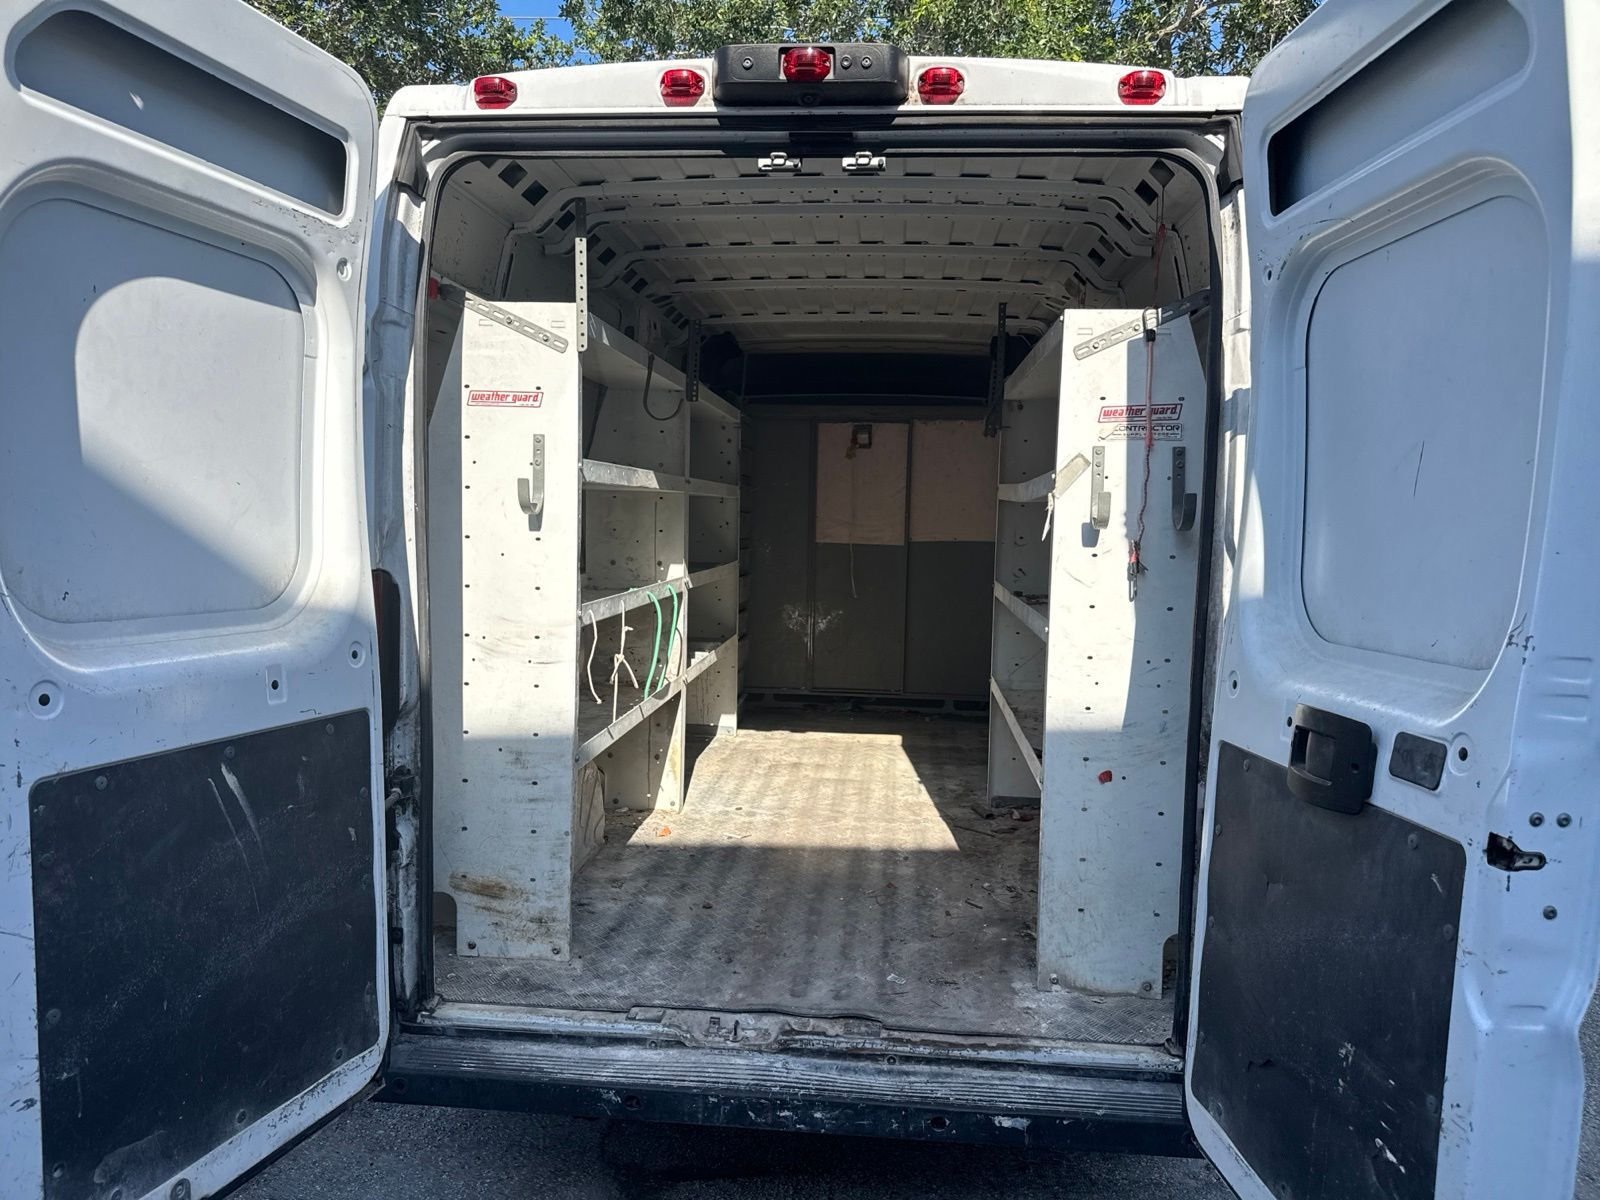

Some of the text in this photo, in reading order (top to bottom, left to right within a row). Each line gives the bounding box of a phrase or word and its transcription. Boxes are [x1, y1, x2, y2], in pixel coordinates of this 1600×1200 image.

[471, 391, 539, 402] weather guard
[1103, 405, 1177, 416] weather uard
